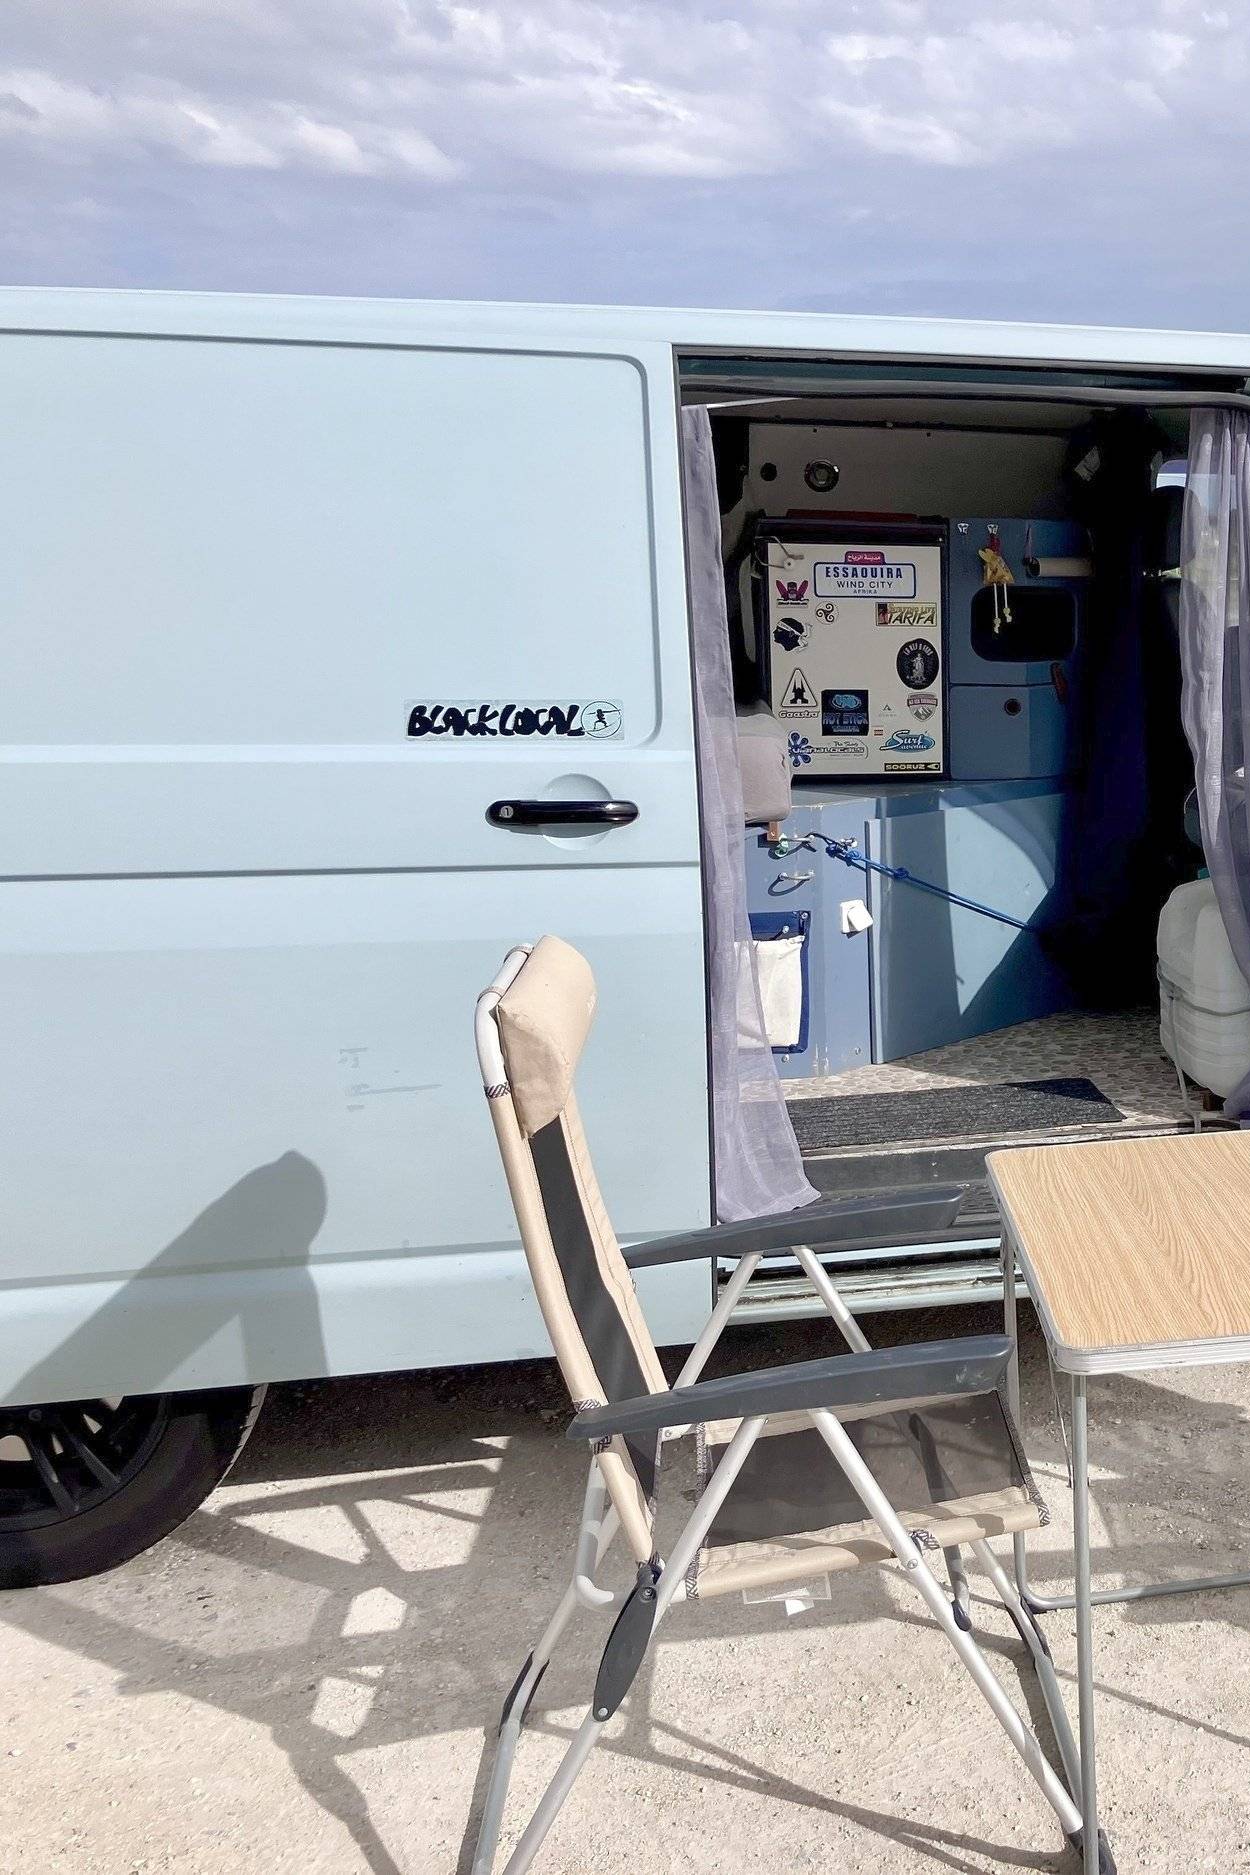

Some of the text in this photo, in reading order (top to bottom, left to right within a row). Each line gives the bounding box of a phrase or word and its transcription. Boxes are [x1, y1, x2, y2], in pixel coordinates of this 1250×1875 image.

[825, 566, 903, 579] ESSAOUIRA
[836, 580, 893, 589] WIND CITY
[888, 611, 935, 625] TARIFA
[779, 709, 820, 719] Gaastra
